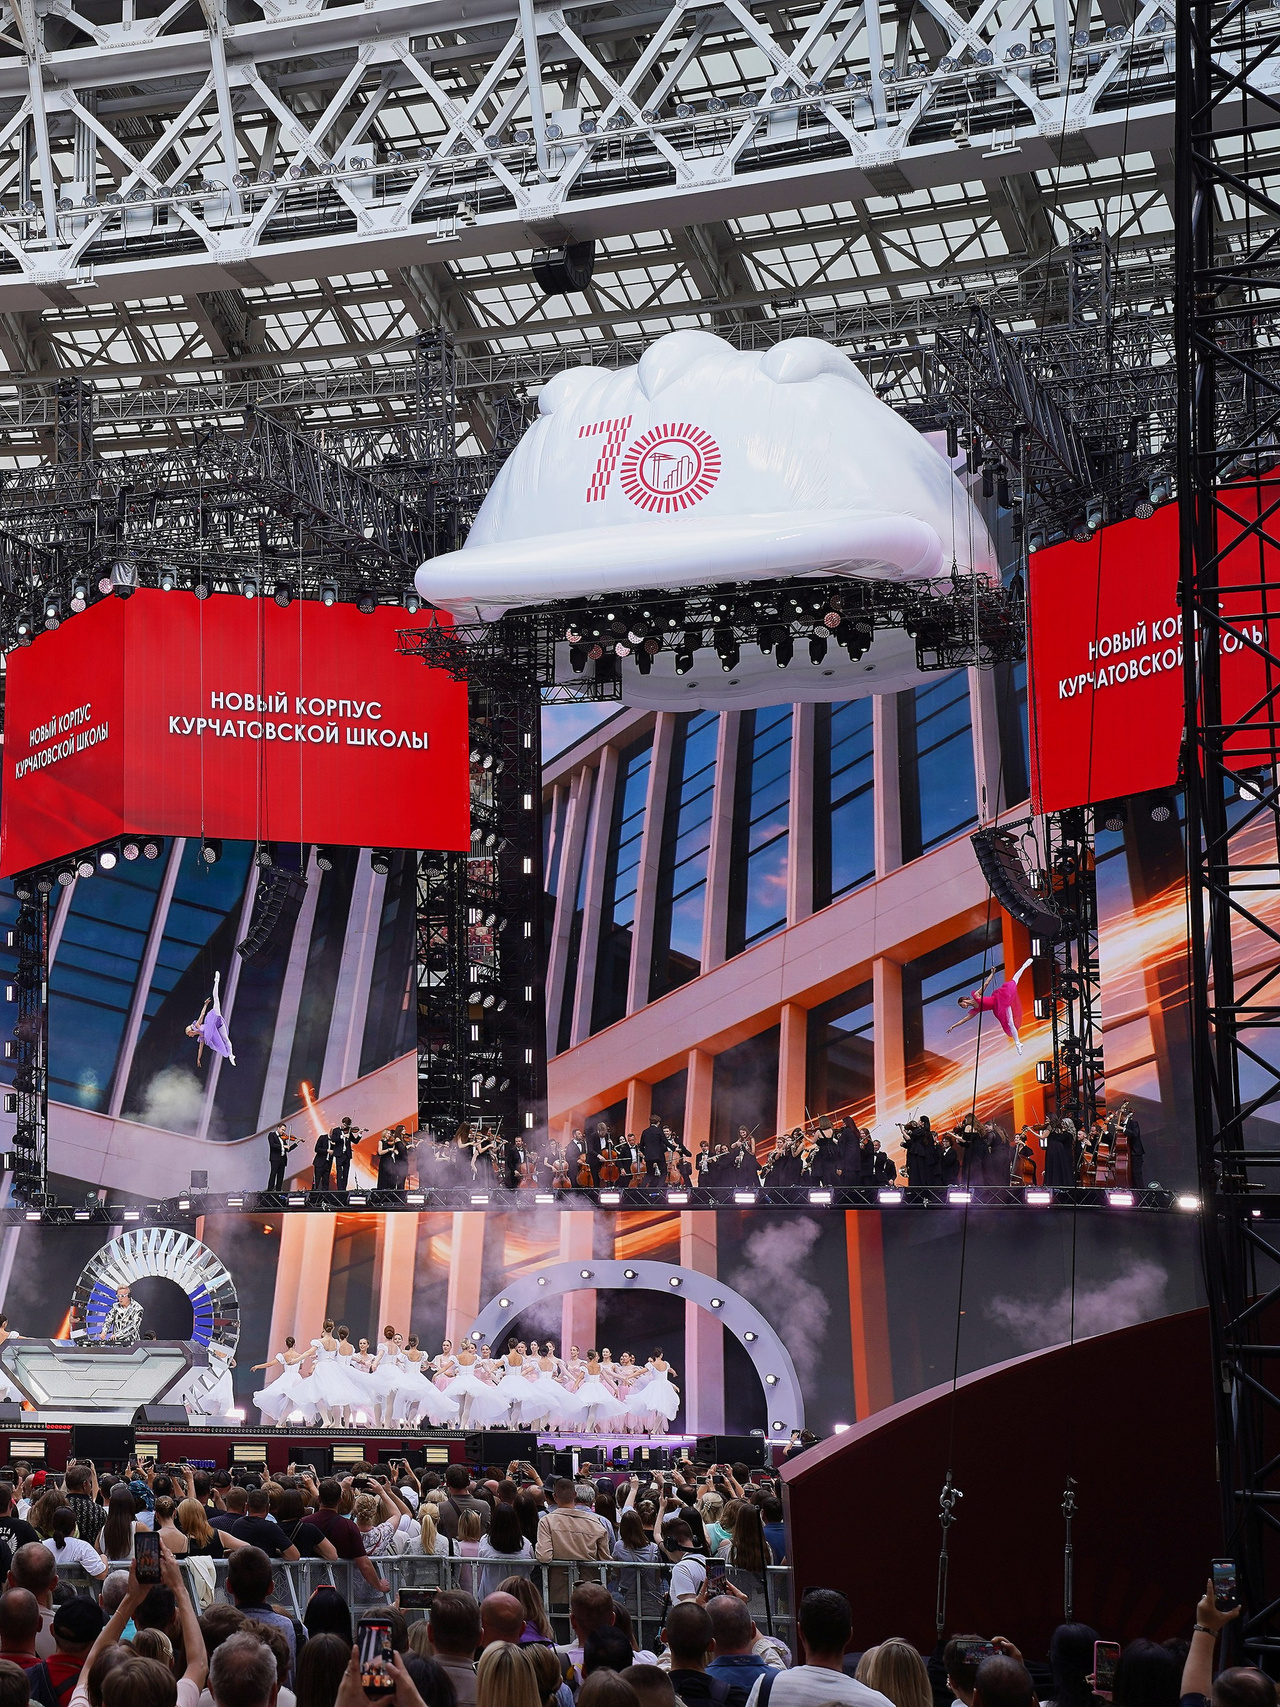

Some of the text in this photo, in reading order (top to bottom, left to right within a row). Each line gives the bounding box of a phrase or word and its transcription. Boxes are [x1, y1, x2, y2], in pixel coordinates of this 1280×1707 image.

[1088, 620, 1147, 661] НОВЫЙ
[29, 703, 91, 747] НОВЫЙ КОРПУС
[211, 691, 382, 720] НОВЫЙ КОРПУС
[15, 721, 109, 779] КУРЧАТОВСКОЙ ШКОЛЫ
[169, 715, 429, 750] КУРЧАТОВСКОЙ ШКОЛЫ
